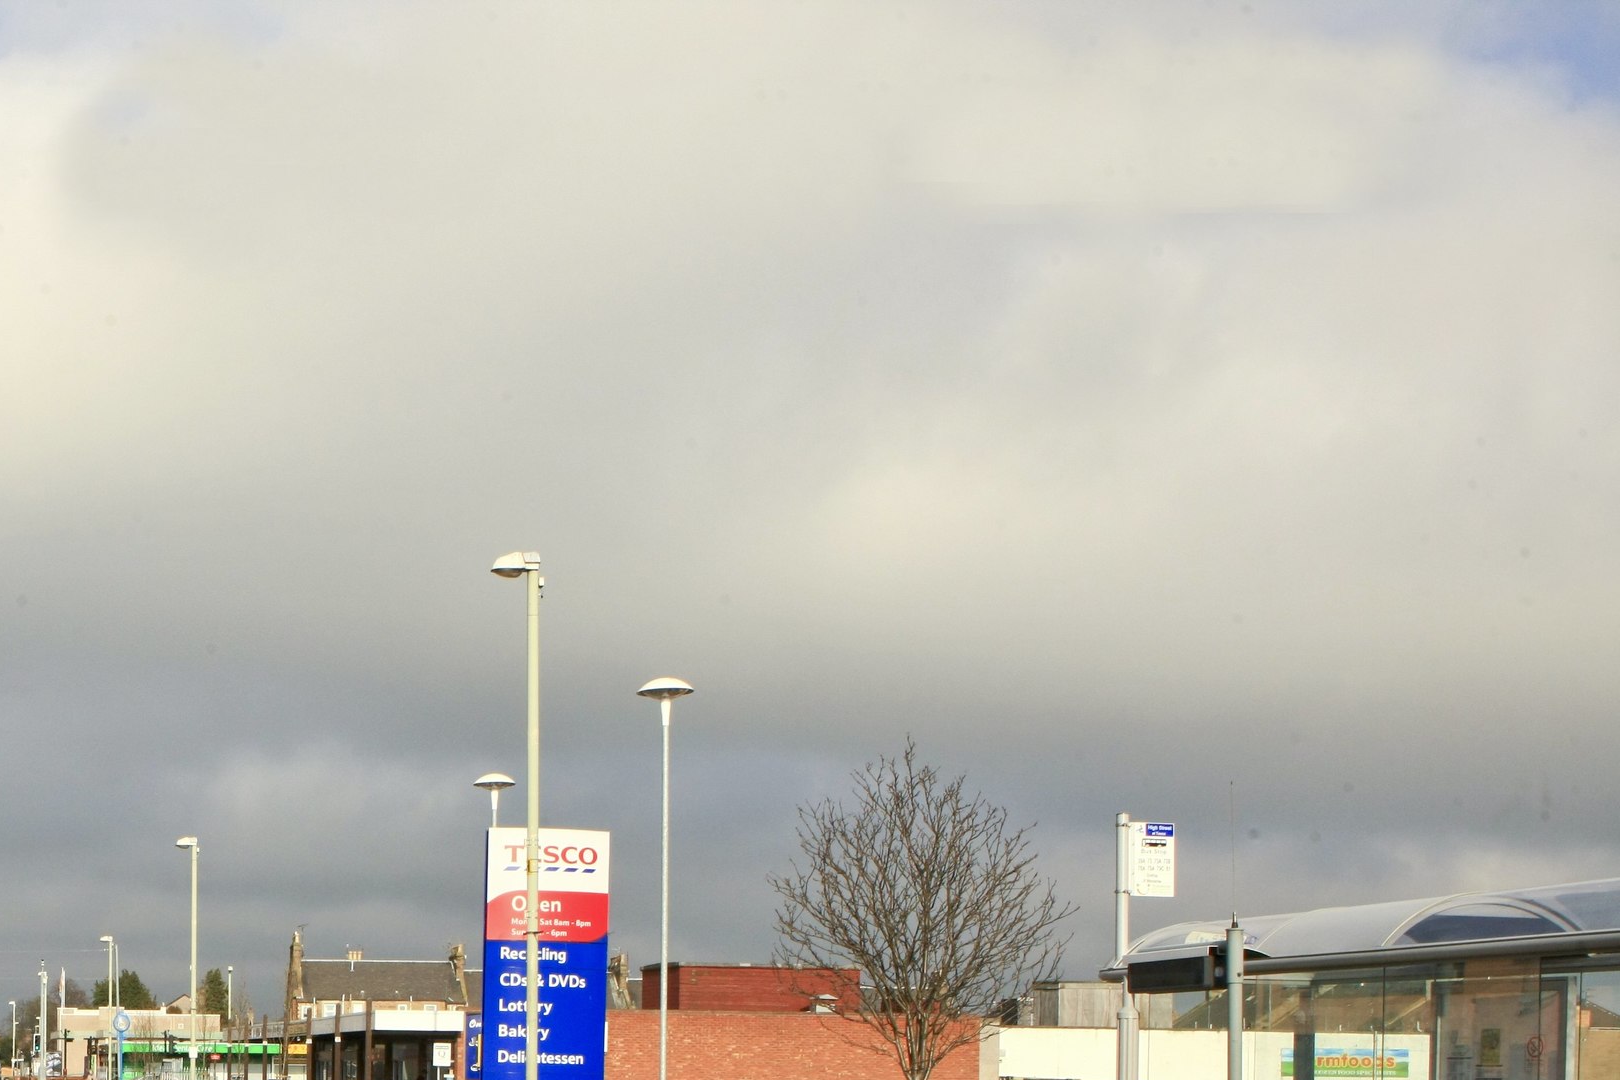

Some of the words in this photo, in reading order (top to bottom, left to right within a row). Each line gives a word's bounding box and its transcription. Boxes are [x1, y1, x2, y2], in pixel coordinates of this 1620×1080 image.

[504, 845, 598, 865] TSCO
[511, 895, 562, 912] Oen
[540, 918, 553, 926] Sat
[553, 919, 570, 927] 8am
[575, 920, 592, 928] 8pm
[551, 929, 568, 938] 6pm
[500, 946, 567, 964] Reccling
[499, 973, 528, 987] CDs
[548, 974, 586, 989] DVDs
[498, 998, 553, 1015] Lottry
[498, 1024, 550, 1041] Bakry
[497, 1050, 584, 1065] Deliatessen
[1316, 1053, 1396, 1068] rmfoods
